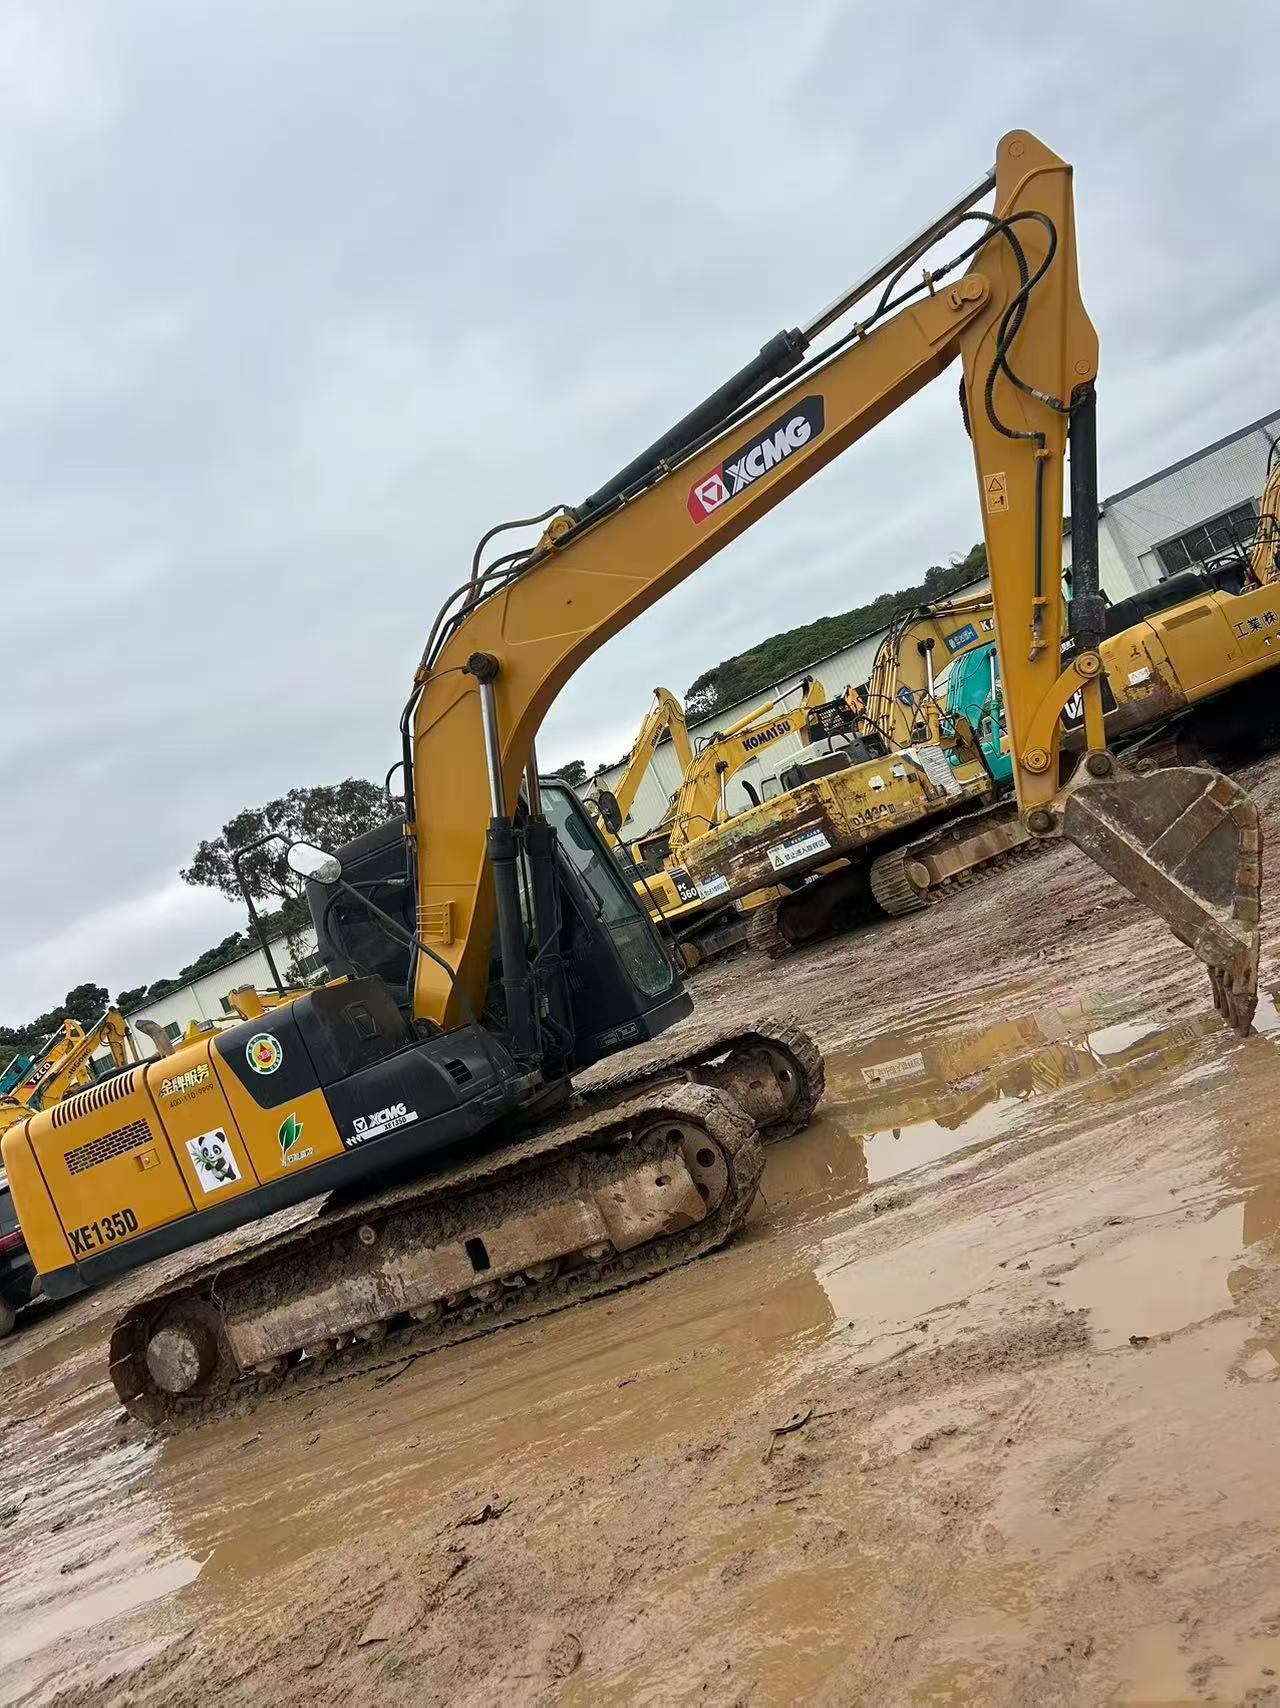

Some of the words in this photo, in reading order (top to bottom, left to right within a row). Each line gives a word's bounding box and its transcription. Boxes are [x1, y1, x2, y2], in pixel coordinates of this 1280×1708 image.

[725, 416, 812, 496] XCMG
[742, 720, 791, 751] KOMATSU
[677, 882, 687, 892] PC
[680, 887, 697, 900] 360
[29, 1062, 51, 1084] TZCO
[160, 1063, 210, 1098] 金牌服务
[368, 1102, 407, 1129] XCMG
[384, 1116, 407, 1131] XE135D
[68, 1208, 138, 1255] XE135D
